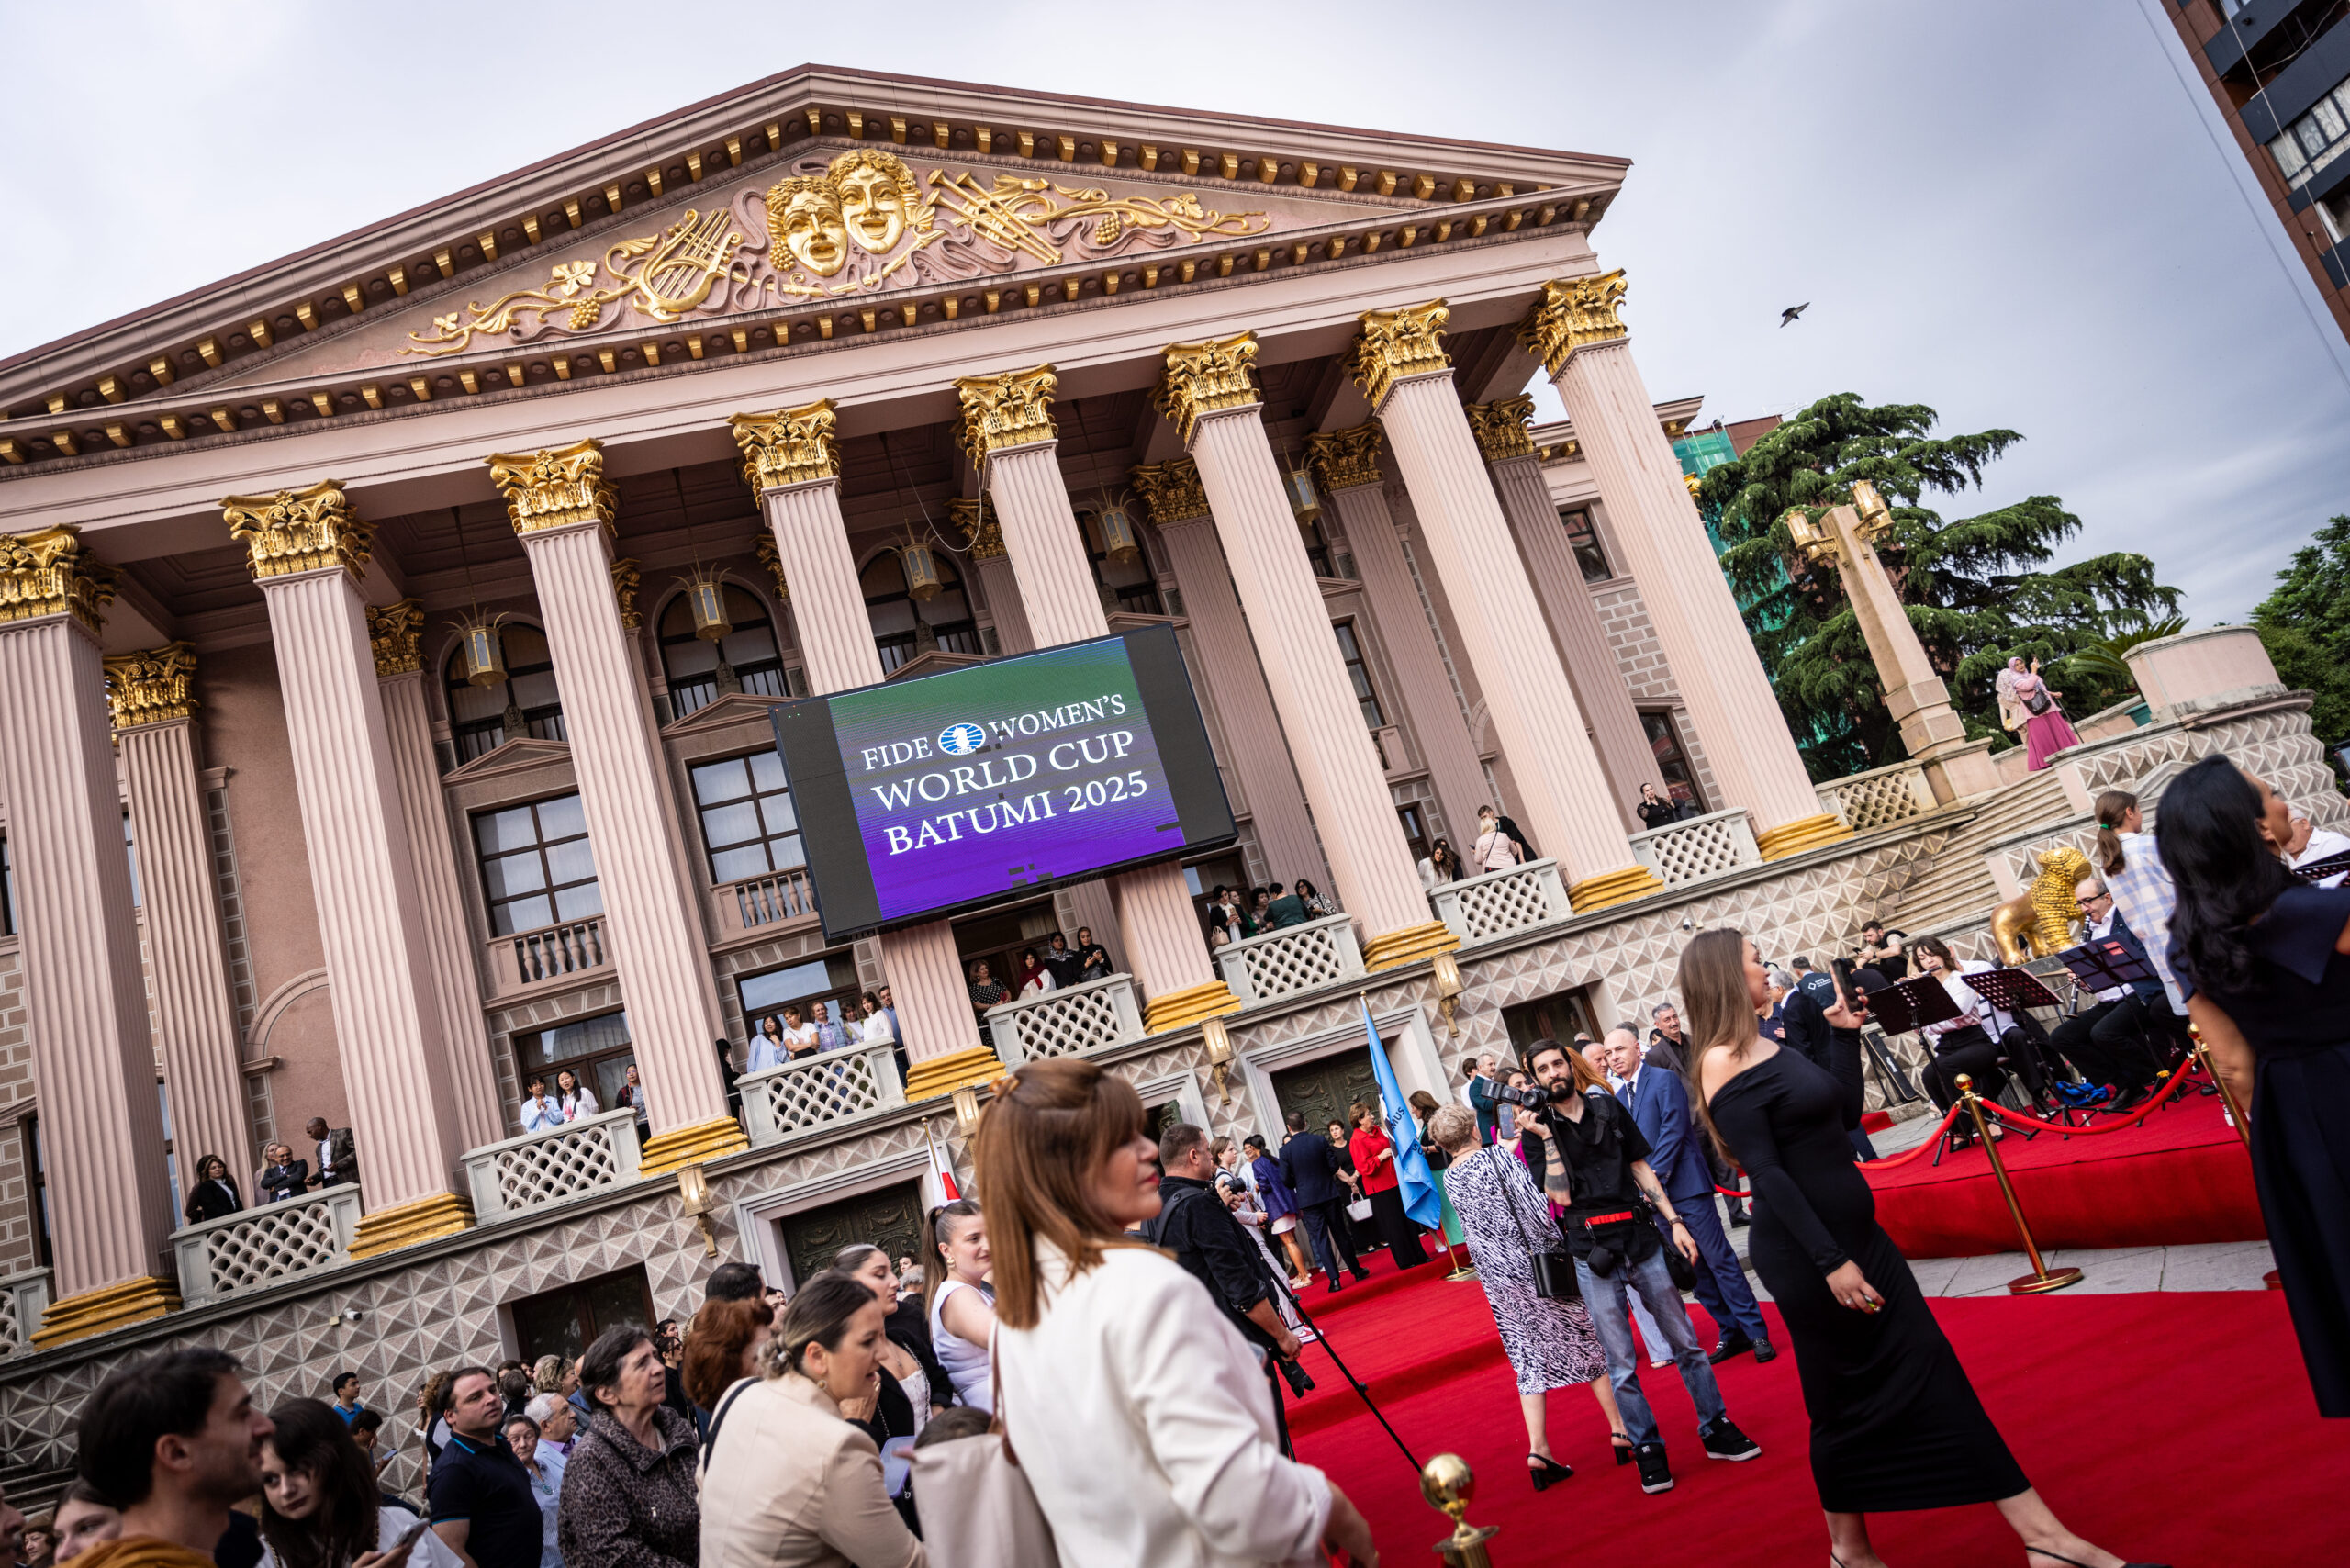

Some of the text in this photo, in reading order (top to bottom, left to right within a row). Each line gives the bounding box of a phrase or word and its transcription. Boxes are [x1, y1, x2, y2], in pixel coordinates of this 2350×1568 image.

[860, 694, 1127, 771] FIDE WOMEN'S
[870, 730, 1134, 811] WORLD CUP
[883, 770, 1148, 856] BATUMI 2025
